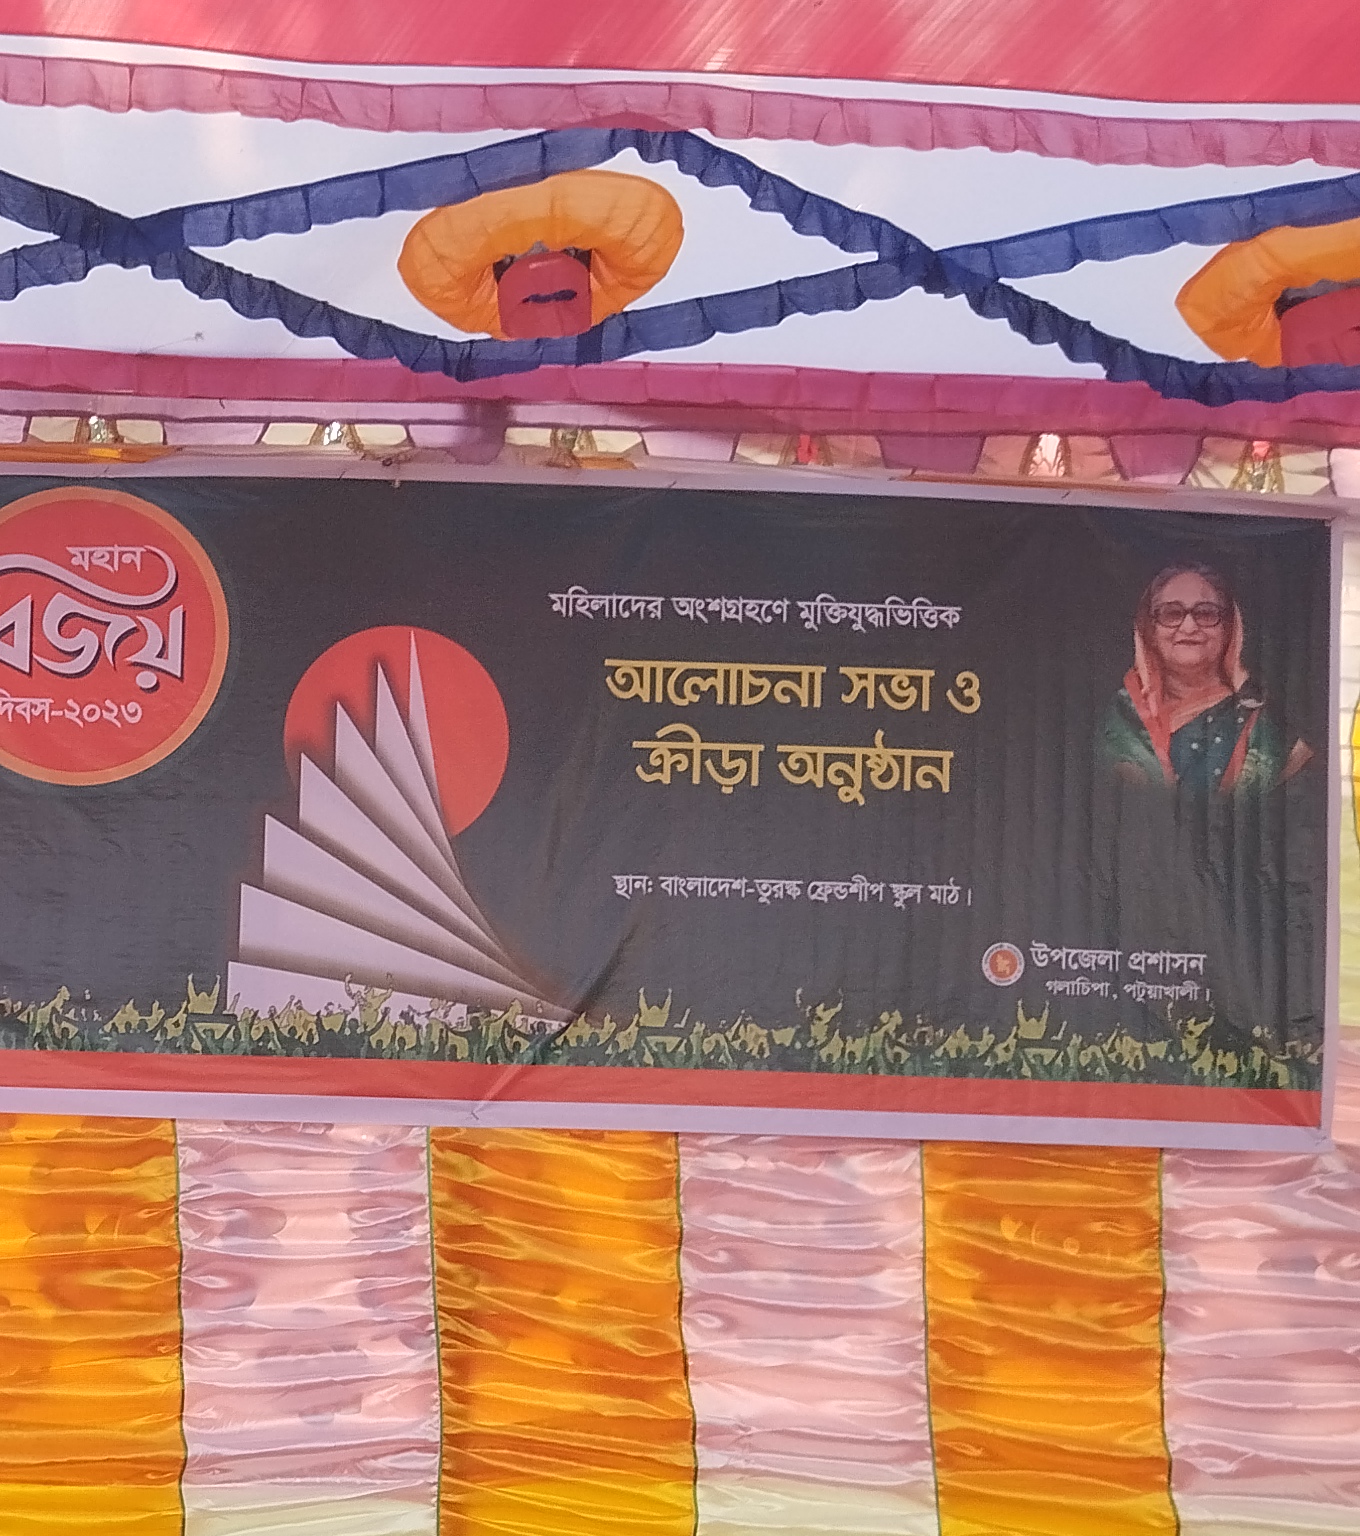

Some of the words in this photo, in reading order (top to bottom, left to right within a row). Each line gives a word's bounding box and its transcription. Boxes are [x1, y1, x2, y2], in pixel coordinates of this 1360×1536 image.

[66, 544, 147, 573] মহান
[548, 585, 665, 620] মহিলাদের
[671, 597, 788, 625] অংশগ্রহণে
[796, 592, 963, 634] মুক্তিযুদ্ধভিত্তিক
[604, 658, 827, 708] আলোচনা
[838, 666, 936, 712] সভা
[945, 670, 982, 715] ও
[632, 723, 765, 794] ক্রীড়া
[776, 729, 954, 806] অনুষ্ঠান
[889, 883, 924, 911] স্কুল
[1030, 940, 1123, 973] উপজেলা
[1127, 949, 1208, 976] প্রশাসন
